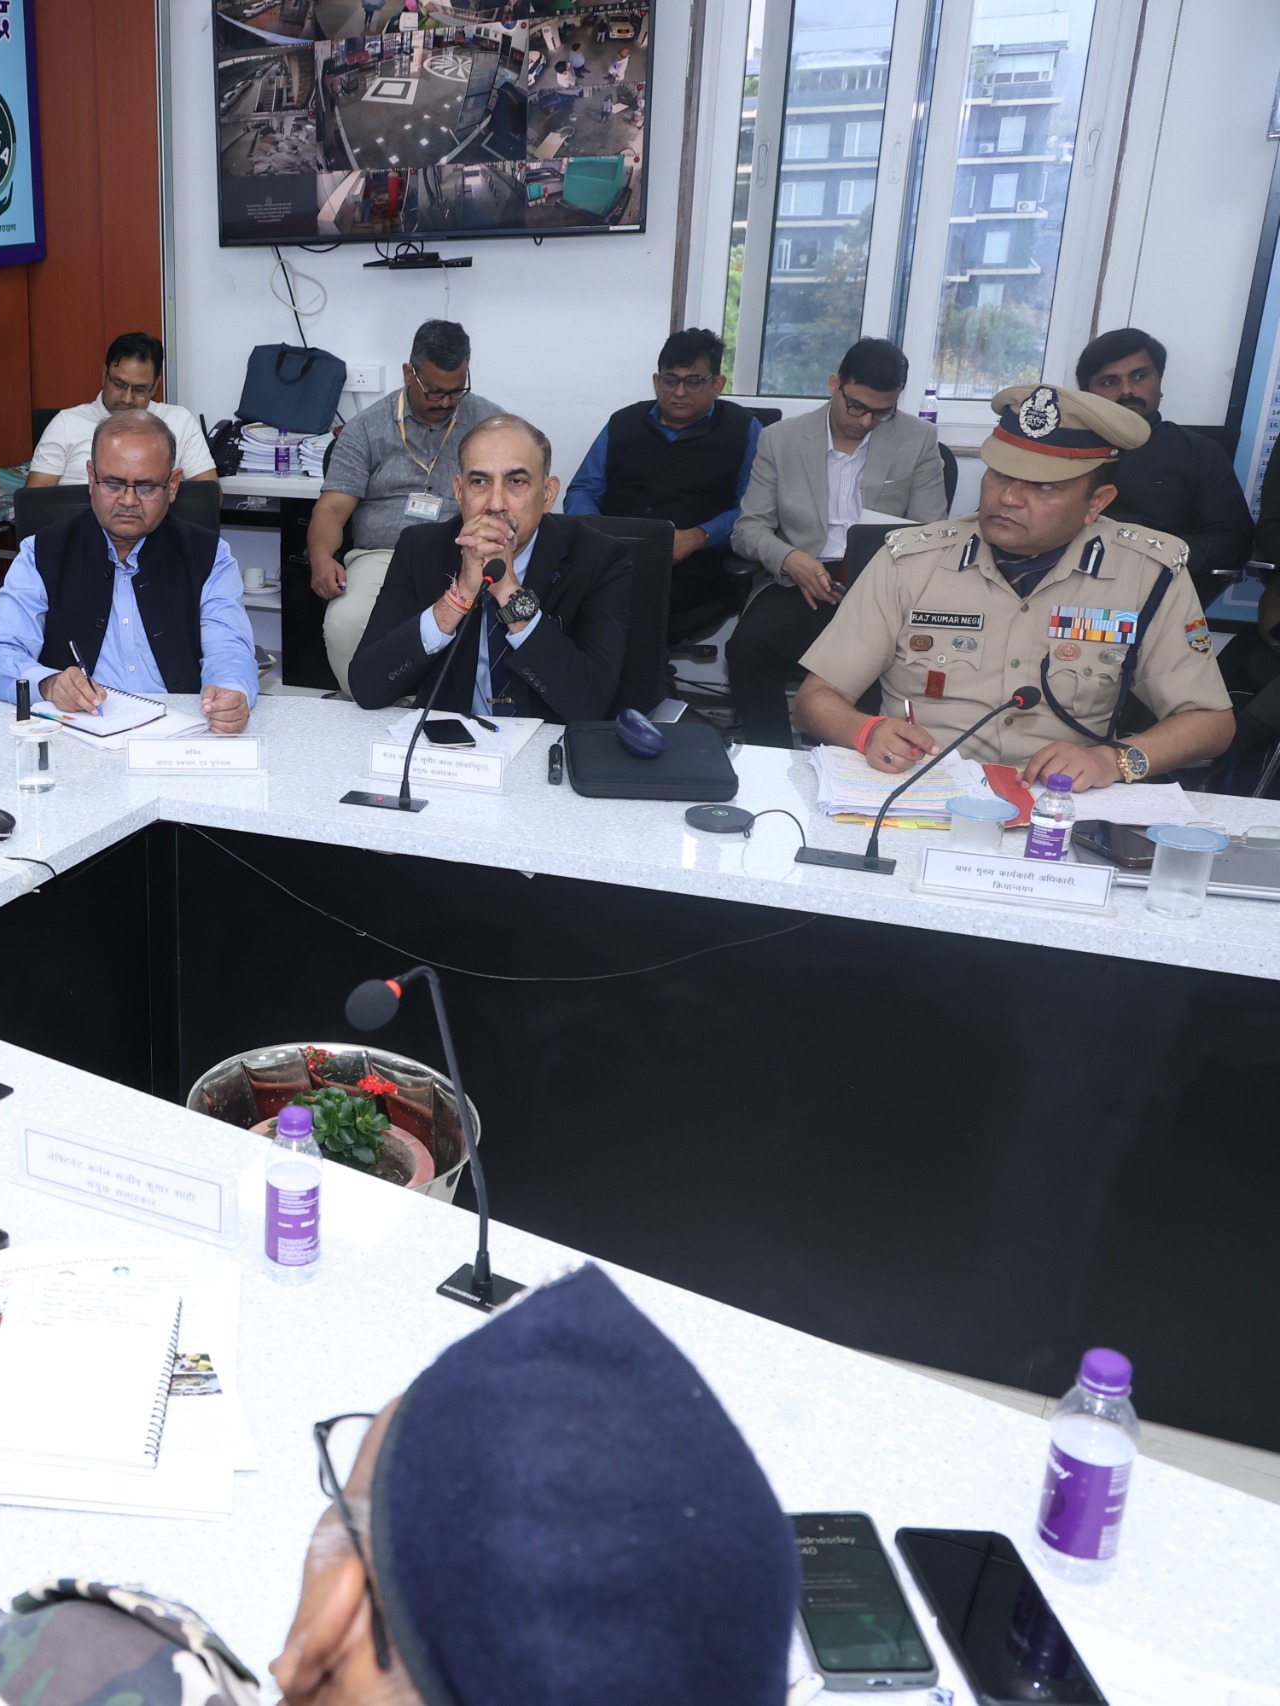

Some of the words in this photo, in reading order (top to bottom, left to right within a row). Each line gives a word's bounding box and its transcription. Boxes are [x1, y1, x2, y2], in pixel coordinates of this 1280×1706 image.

[912, 613, 931, 622] RAJ
[931, 615, 960, 624] KUMAR
[961, 617, 980, 625] NEGI
[954, 865, 972, 873] अपर
[976, 867, 995, 876] मुख्य
[998, 869, 1034, 881] कार्यकारी
[794, 1536, 856, 1546] ednesday
